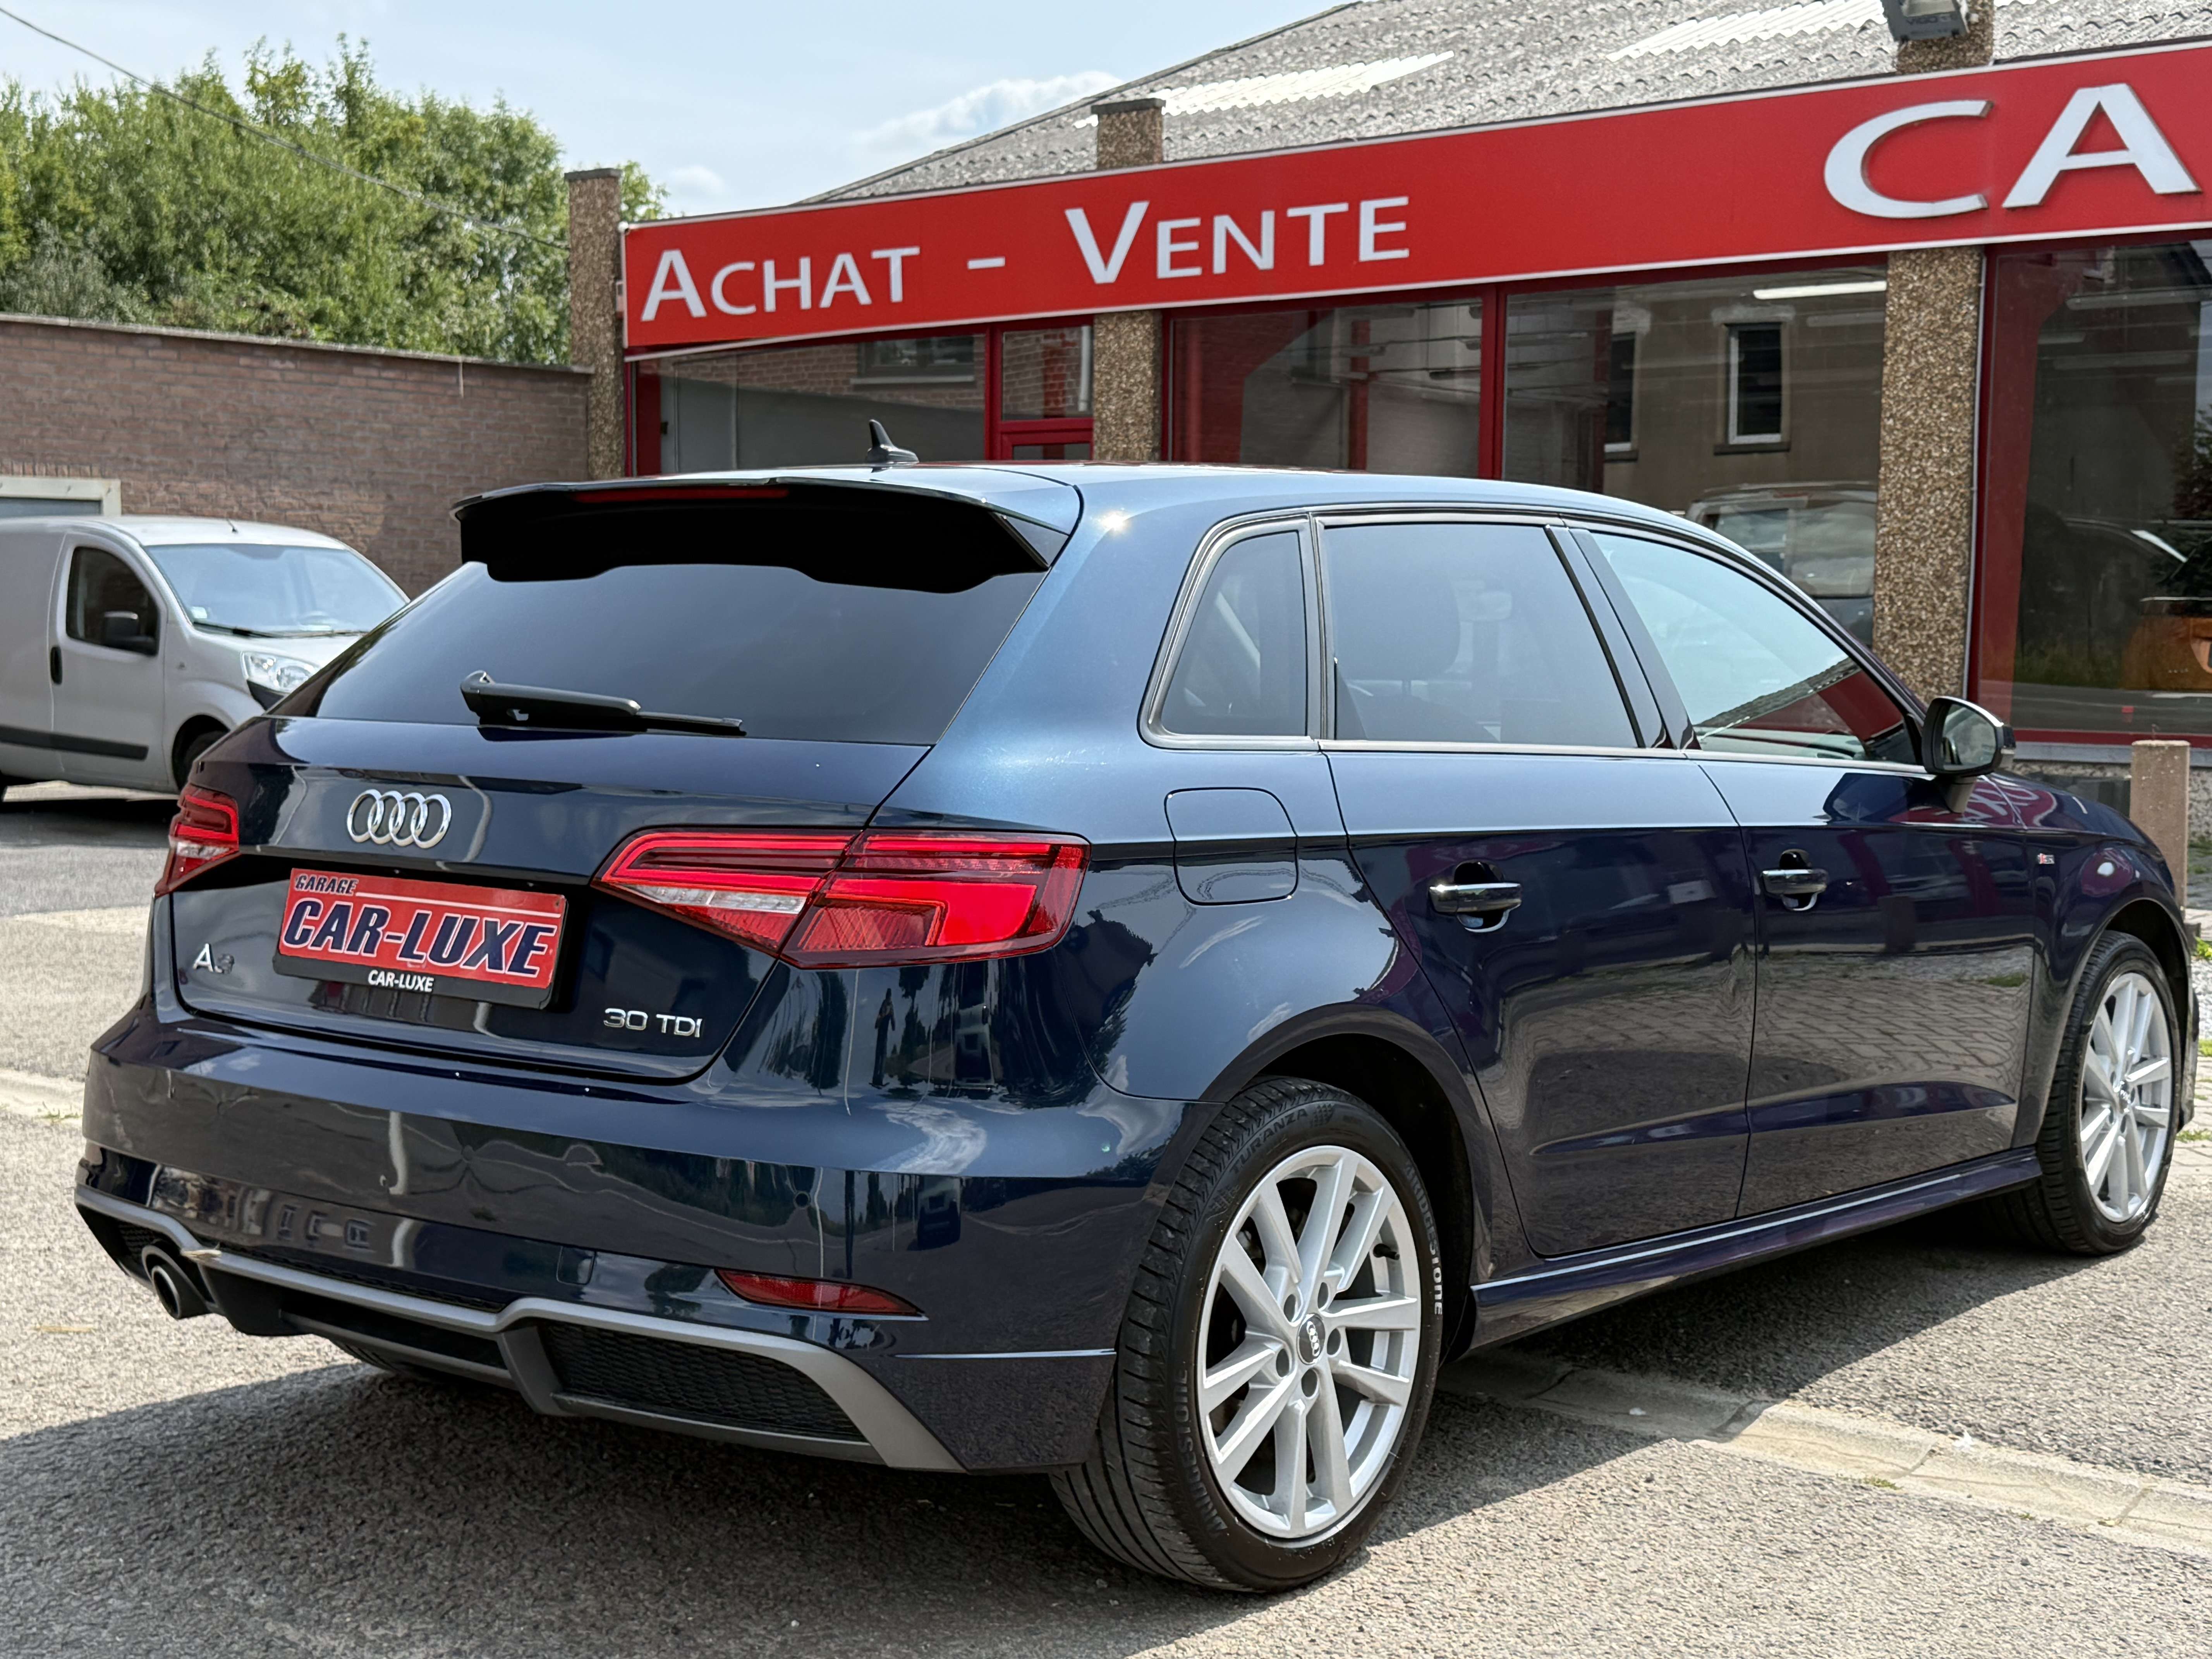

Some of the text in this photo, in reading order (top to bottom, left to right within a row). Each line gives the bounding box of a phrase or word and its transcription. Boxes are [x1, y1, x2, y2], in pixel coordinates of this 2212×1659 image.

[641, 247, 920, 321] ACHAT
[1065, 196, 1410, 284] VENTE
[1824, 83, 2203, 218] CA
[295, 874, 359, 896] GARAGE
[283, 898, 556, 978] CAR-LUXE
[368, 969, 434, 993] CAR-LUXE
[603, 1008, 703, 1038] 30 TDI
[1230, 1108, 1309, 1174] TURANZA
